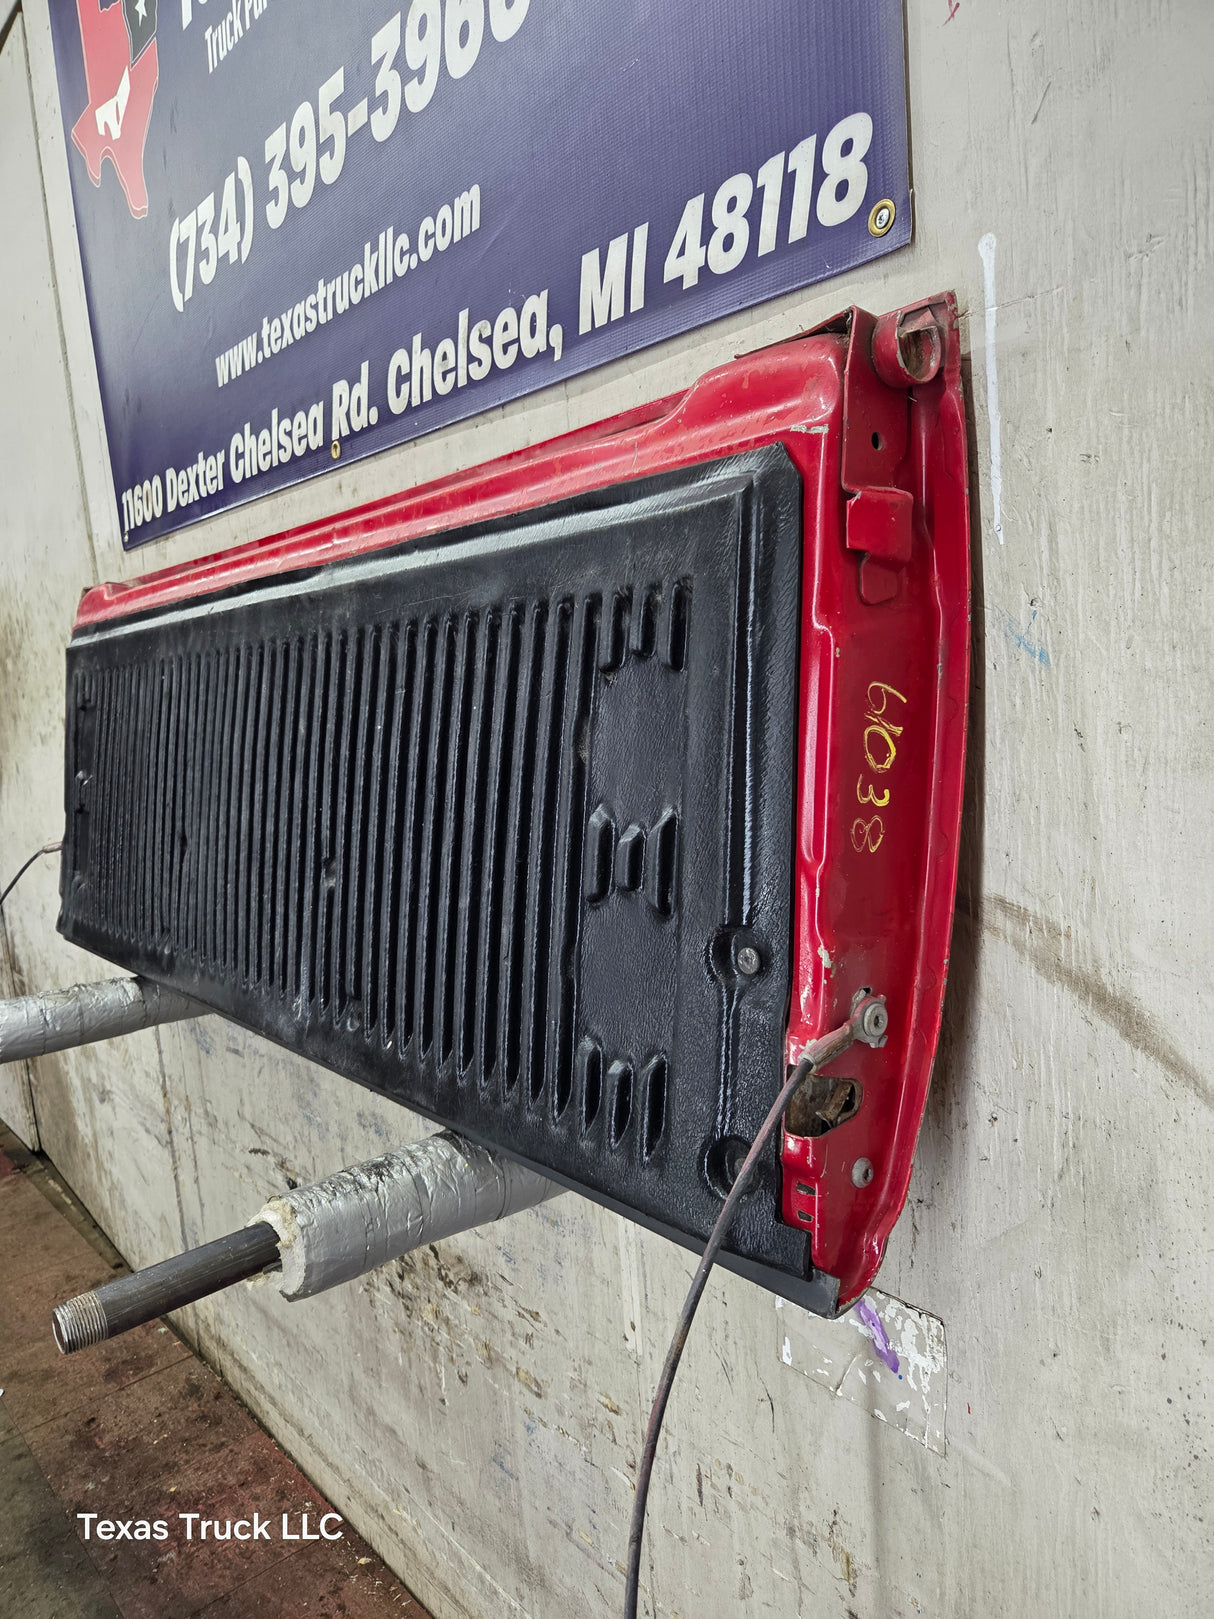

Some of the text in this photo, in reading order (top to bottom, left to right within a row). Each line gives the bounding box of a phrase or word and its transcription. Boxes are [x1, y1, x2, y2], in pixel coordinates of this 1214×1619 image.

[205, 0, 243, 74] Truck
[121, 112, 873, 531] 11600 Dexter Chelsea Rd. Chelsea, MI 48118
[169, 156, 254, 313] (734)
[215, 184, 481, 388] www.texastruckllc.com
